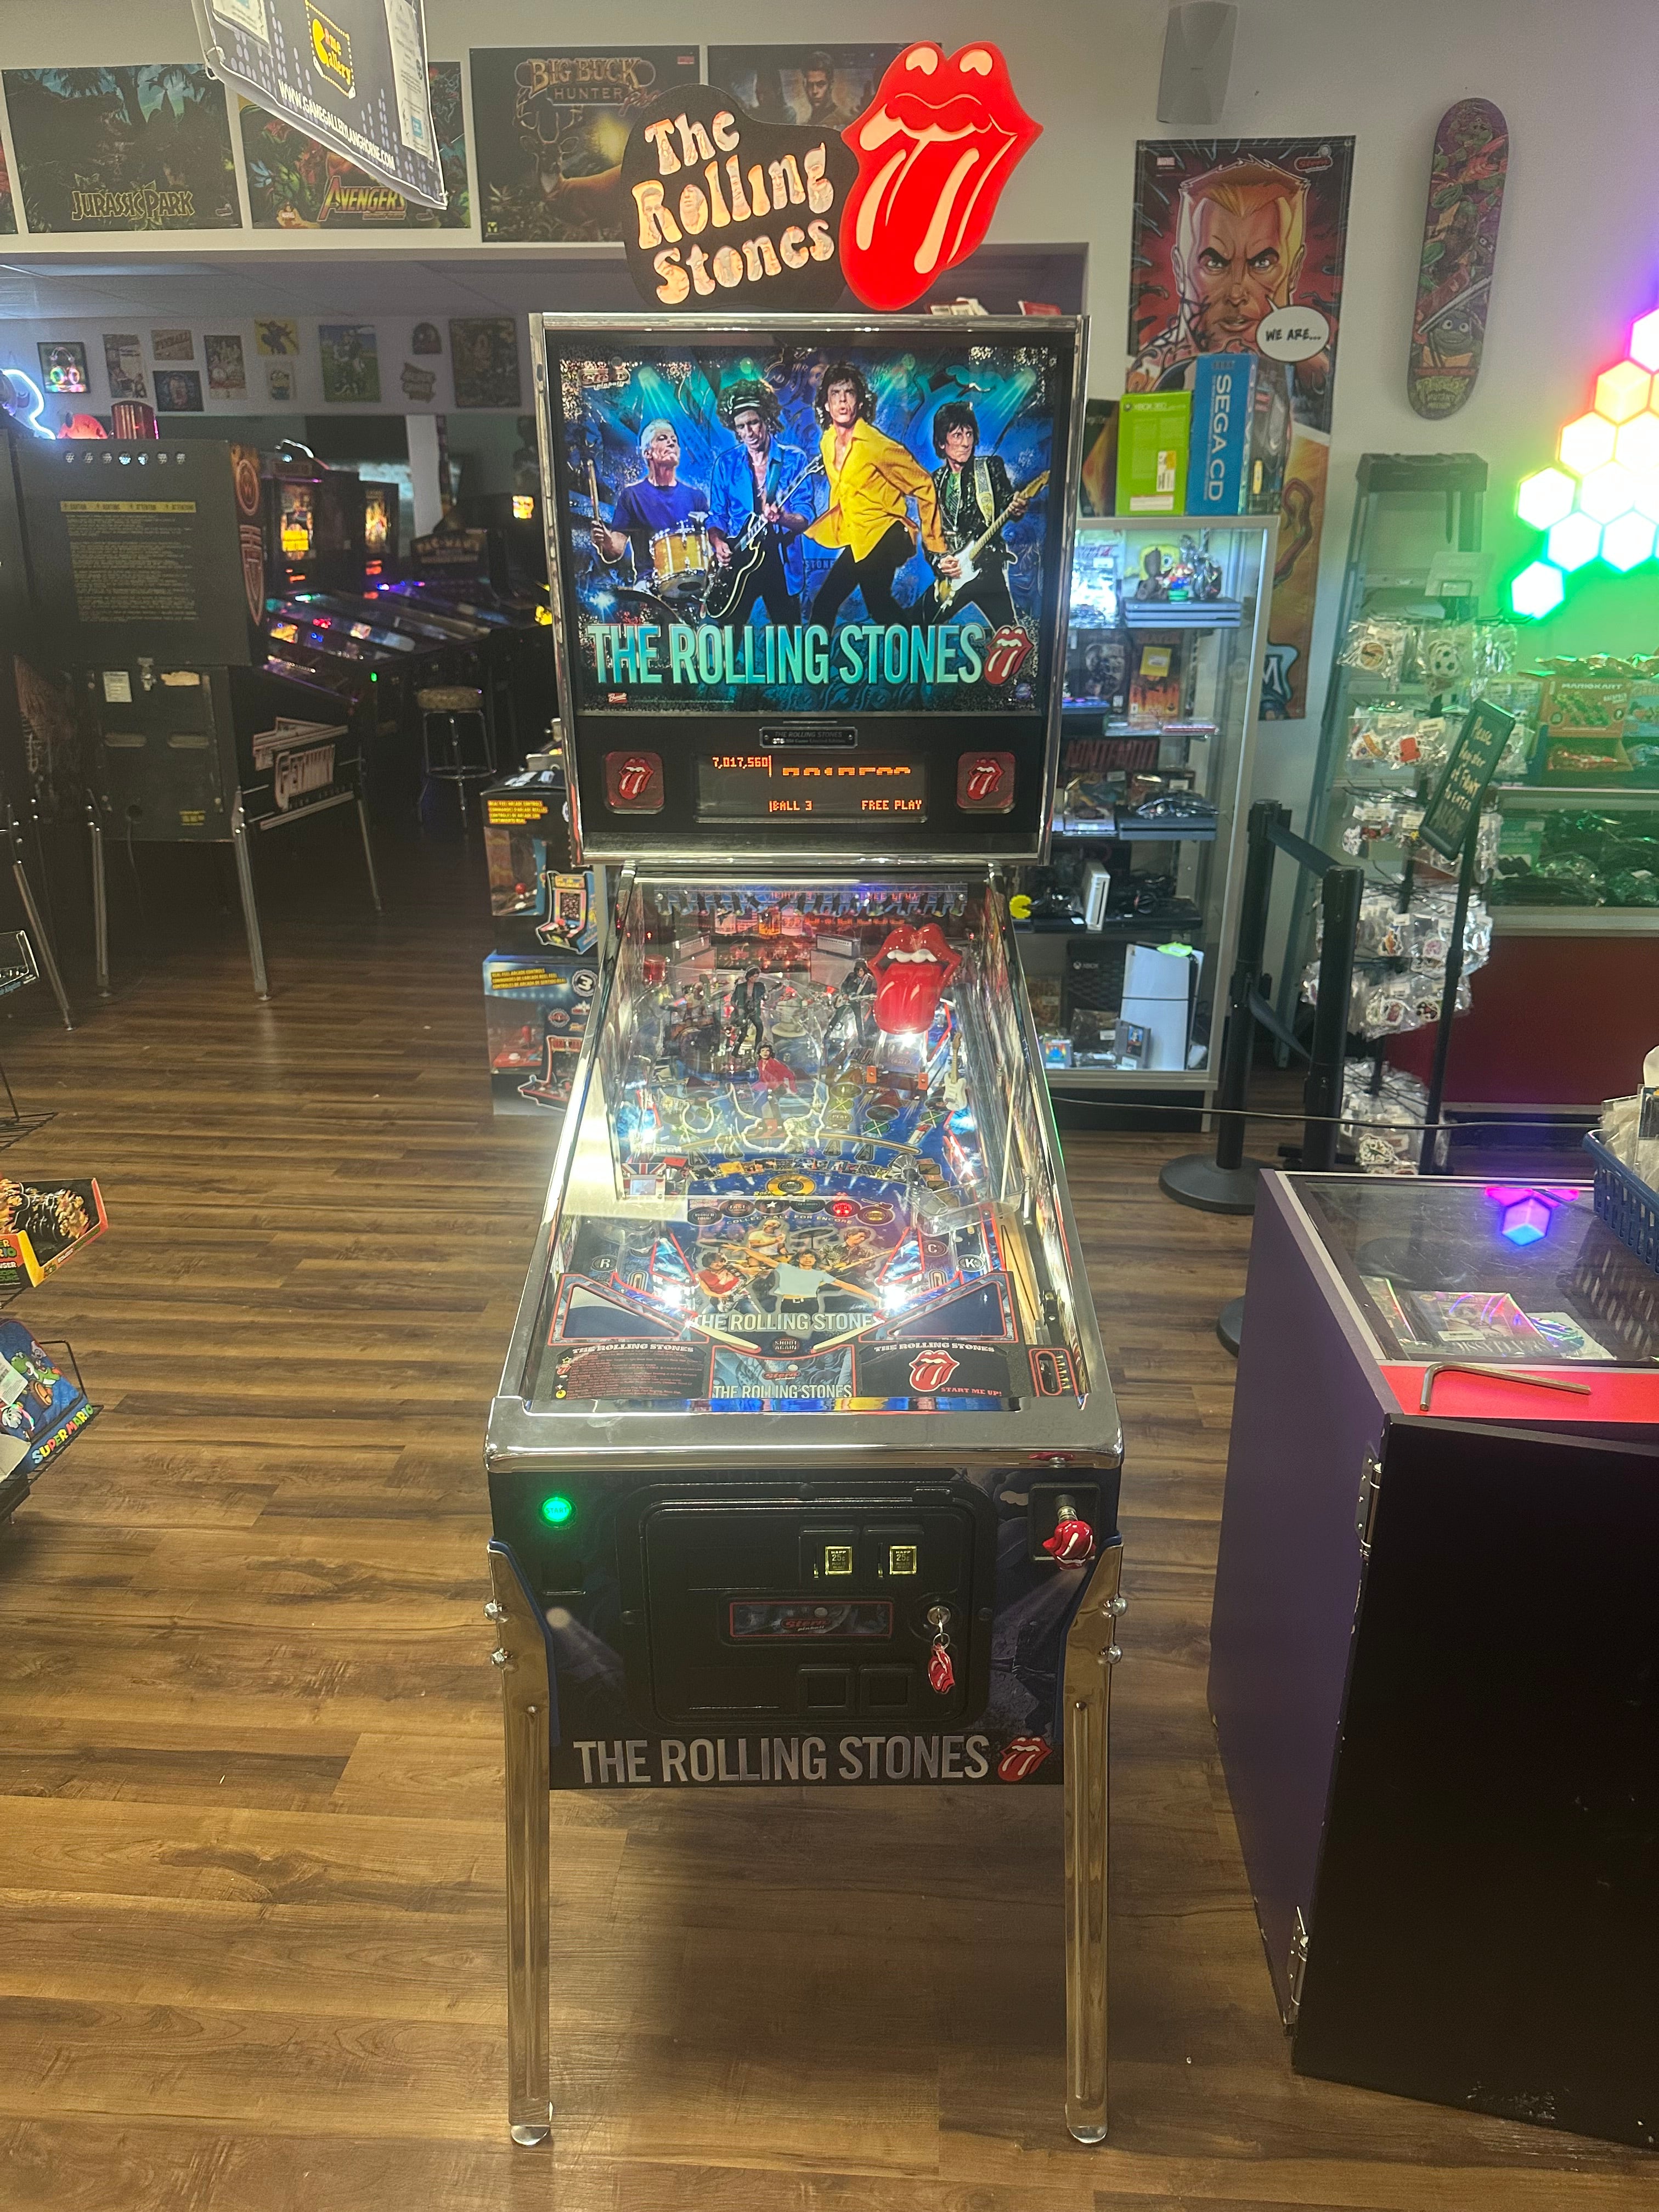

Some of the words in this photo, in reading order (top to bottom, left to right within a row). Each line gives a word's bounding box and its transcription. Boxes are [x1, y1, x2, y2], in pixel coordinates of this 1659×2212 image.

[529, 59, 571, 97] BIG
[576, 58, 640, 89] BUCK
[555, 88, 623, 99] HUNTER
[278, 78, 396, 171] WWW.GAMEGALLERYLANGHORNE.COM
[645, 111, 740, 175] The
[631, 142, 834, 250] Rolling
[72, 191, 144, 221] JURASSIC
[143, 190, 195, 218] PARK
[653, 220, 834, 304] Stones
[1266, 329, 1282, 341] WE
[1286, 328, 1321, 341] ARE...
[1211, 375, 1232, 454] SEGA
[1208, 459, 1225, 501] CD
[588, 624, 660, 684] THE
[669, 625, 830, 684] ROLLING
[839, 624, 985, 684] STONES
[712, 757, 768, 769] 7,017,560
[772, 800, 800, 811] BALL
[805, 800, 812, 810] 3
[862, 800, 889, 810] FREE
[894, 800, 922, 810] PLAY
[578, 974, 593, 991] 3
[727, 1216, 768, 1224] COLLECT
[817, 1216, 853, 1224] ENCORE
[928, 1243, 938, 1253] C
[600, 1259, 611, 1268] R
[966, 1256, 977, 1268] K
[731, 1314, 809, 1331] ROLLING
[650, 1344, 694, 1352] STONES
[951, 1343, 995, 1352] STONES
[713, 1385, 738, 1399] THE
[742, 1385, 797, 1399] ROLLING
[801, 1384, 853, 1398] STONES
[32, 1429, 69, 1464] SUPER
[66, 1404, 93, 1435] MARIO
[574, 1740, 650, 1784] THE
[663, 1737, 827, 1781] ROLLING
[839, 1735, 989, 1779] STONES
